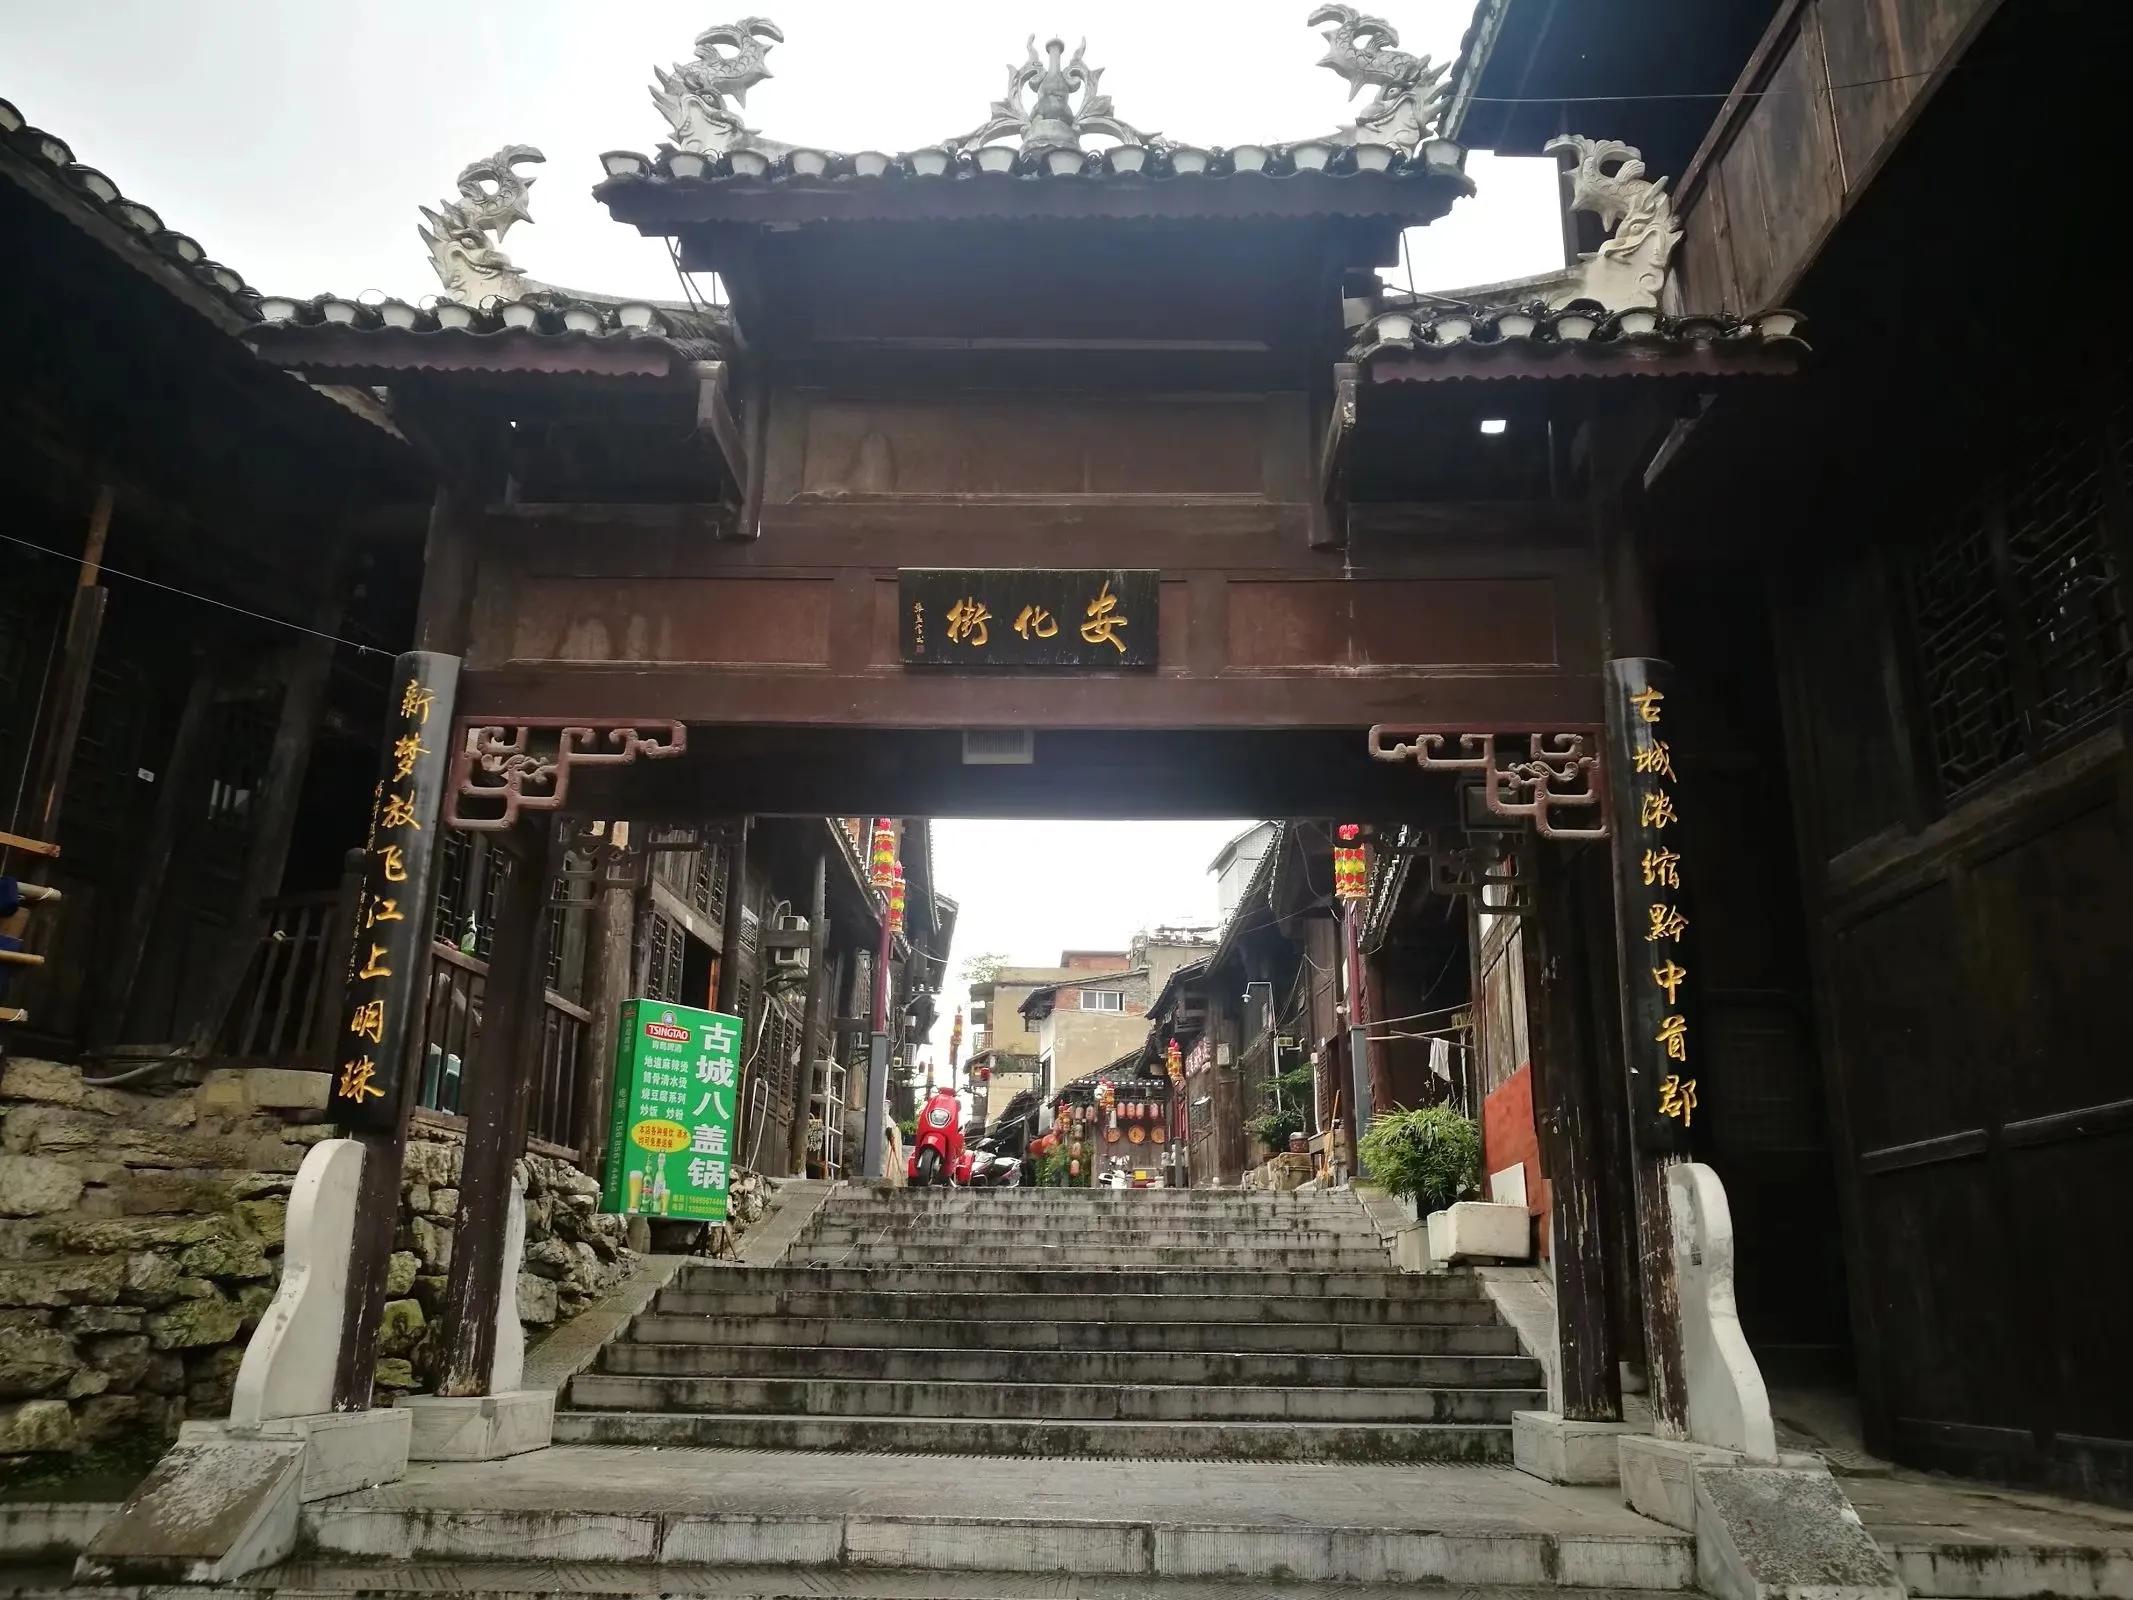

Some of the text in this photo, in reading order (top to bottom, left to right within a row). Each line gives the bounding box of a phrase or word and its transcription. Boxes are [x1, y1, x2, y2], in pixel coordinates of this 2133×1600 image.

[648, 1024, 689, 1042] TSINGTAO
[644, 1055, 689, 1074] 地道麻辣烫
[640, 1087, 687, 1105] 烧豆腐系列
[639, 1103, 658, 1118] 炒饭
[687, 1022, 737, 1190] 古城八盖锅
